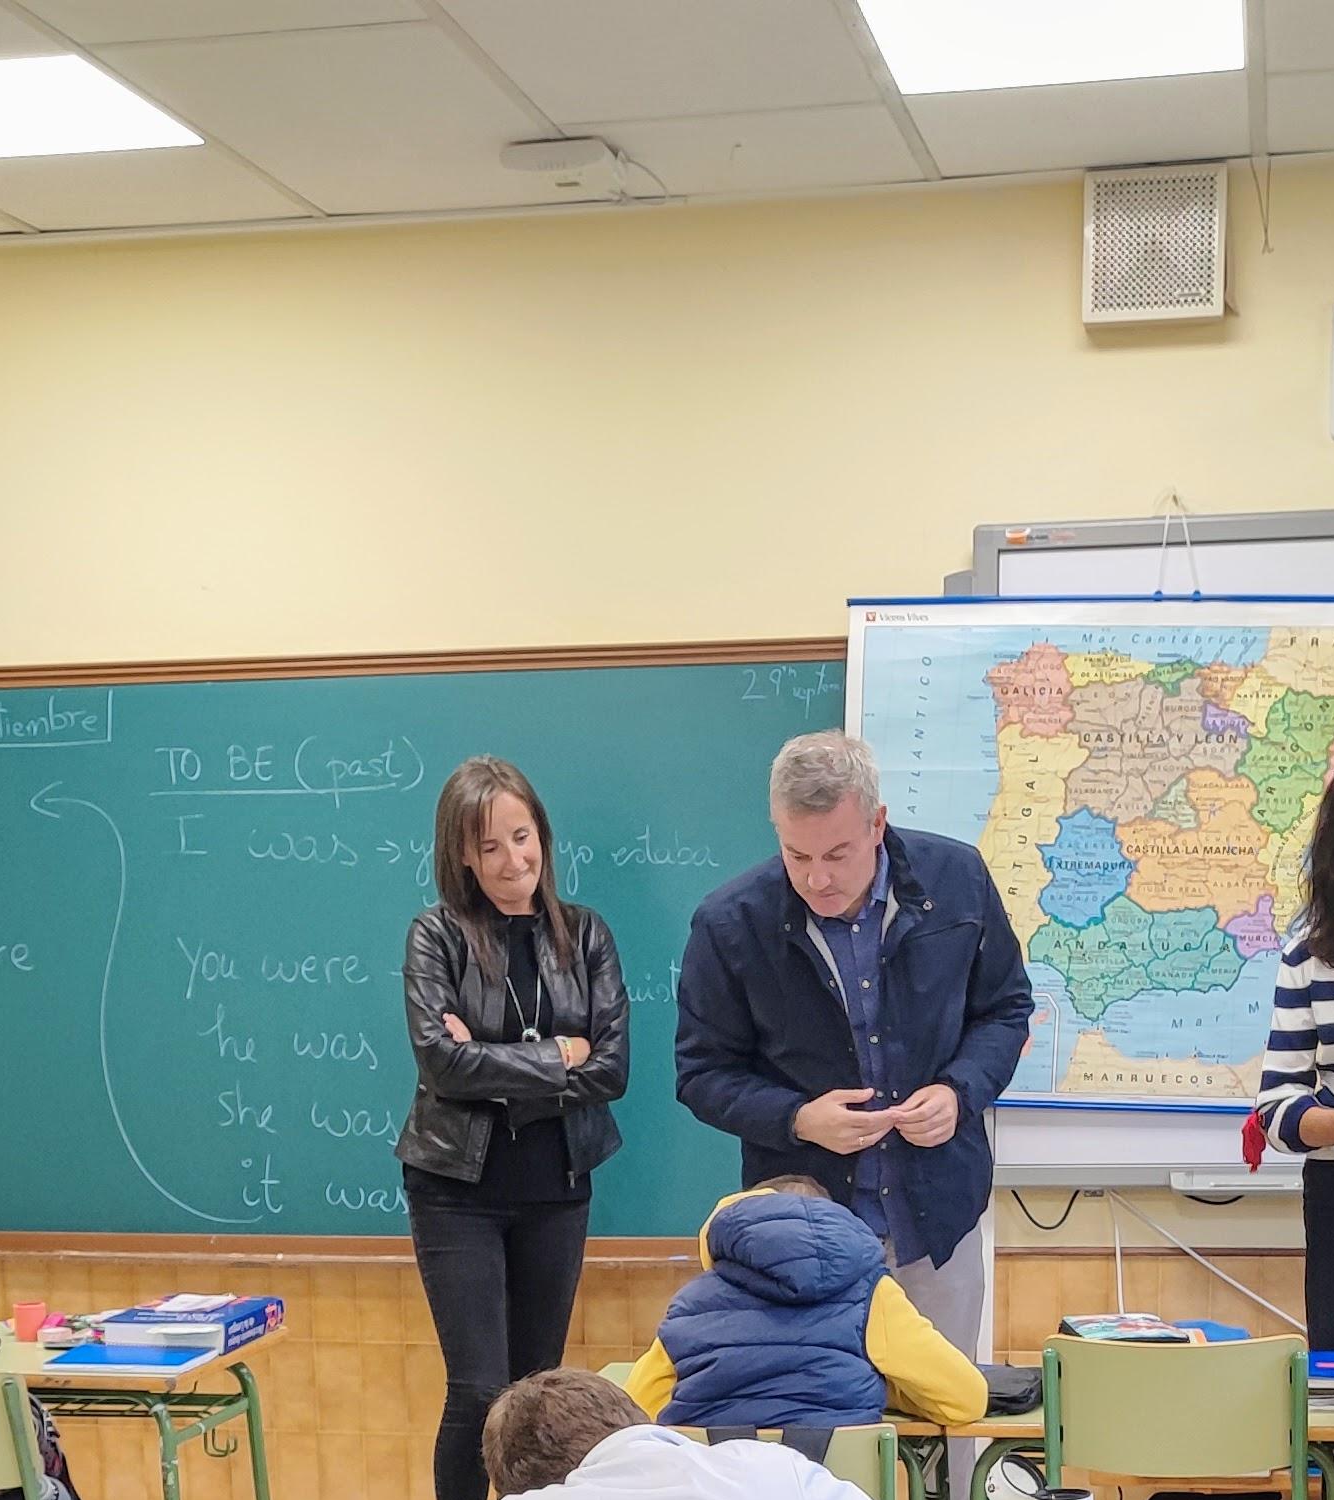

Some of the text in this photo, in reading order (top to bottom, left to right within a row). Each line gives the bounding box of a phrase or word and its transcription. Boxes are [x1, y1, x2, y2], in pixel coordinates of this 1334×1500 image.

[1081, 633, 1257, 644] Mar Cantábrico
[1001, 687, 1063, 695] GALICIA
[1083, 733, 1165, 743] CASTILLA
[1176, 734, 1183, 743] Y
[155, 736, 426, 808] TO BE (past)
[1005, 755, 1039, 920] ORTUGAL
[173, 813, 207, 857] I
[248, 832, 360, 869] was
[559, 840, 594, 896] yo
[610, 824, 720, 868] estaba
[1203, 845, 1254, 855] MANCHA
[1048, 857, 1133, 870] EXTREMADURA
[1237, 934, 1281, 943] MURCIA
[177, 937, 237, 1000] You
[262, 954, 369, 985] were
[1171, 1014, 1222, 1029] Mar
[197, 1004, 378, 1070] he was
[1084, 1073, 1213, 1085] MARRUECOS
[311, 1102, 400, 1146] was
[241, 1154, 410, 1215] it was
